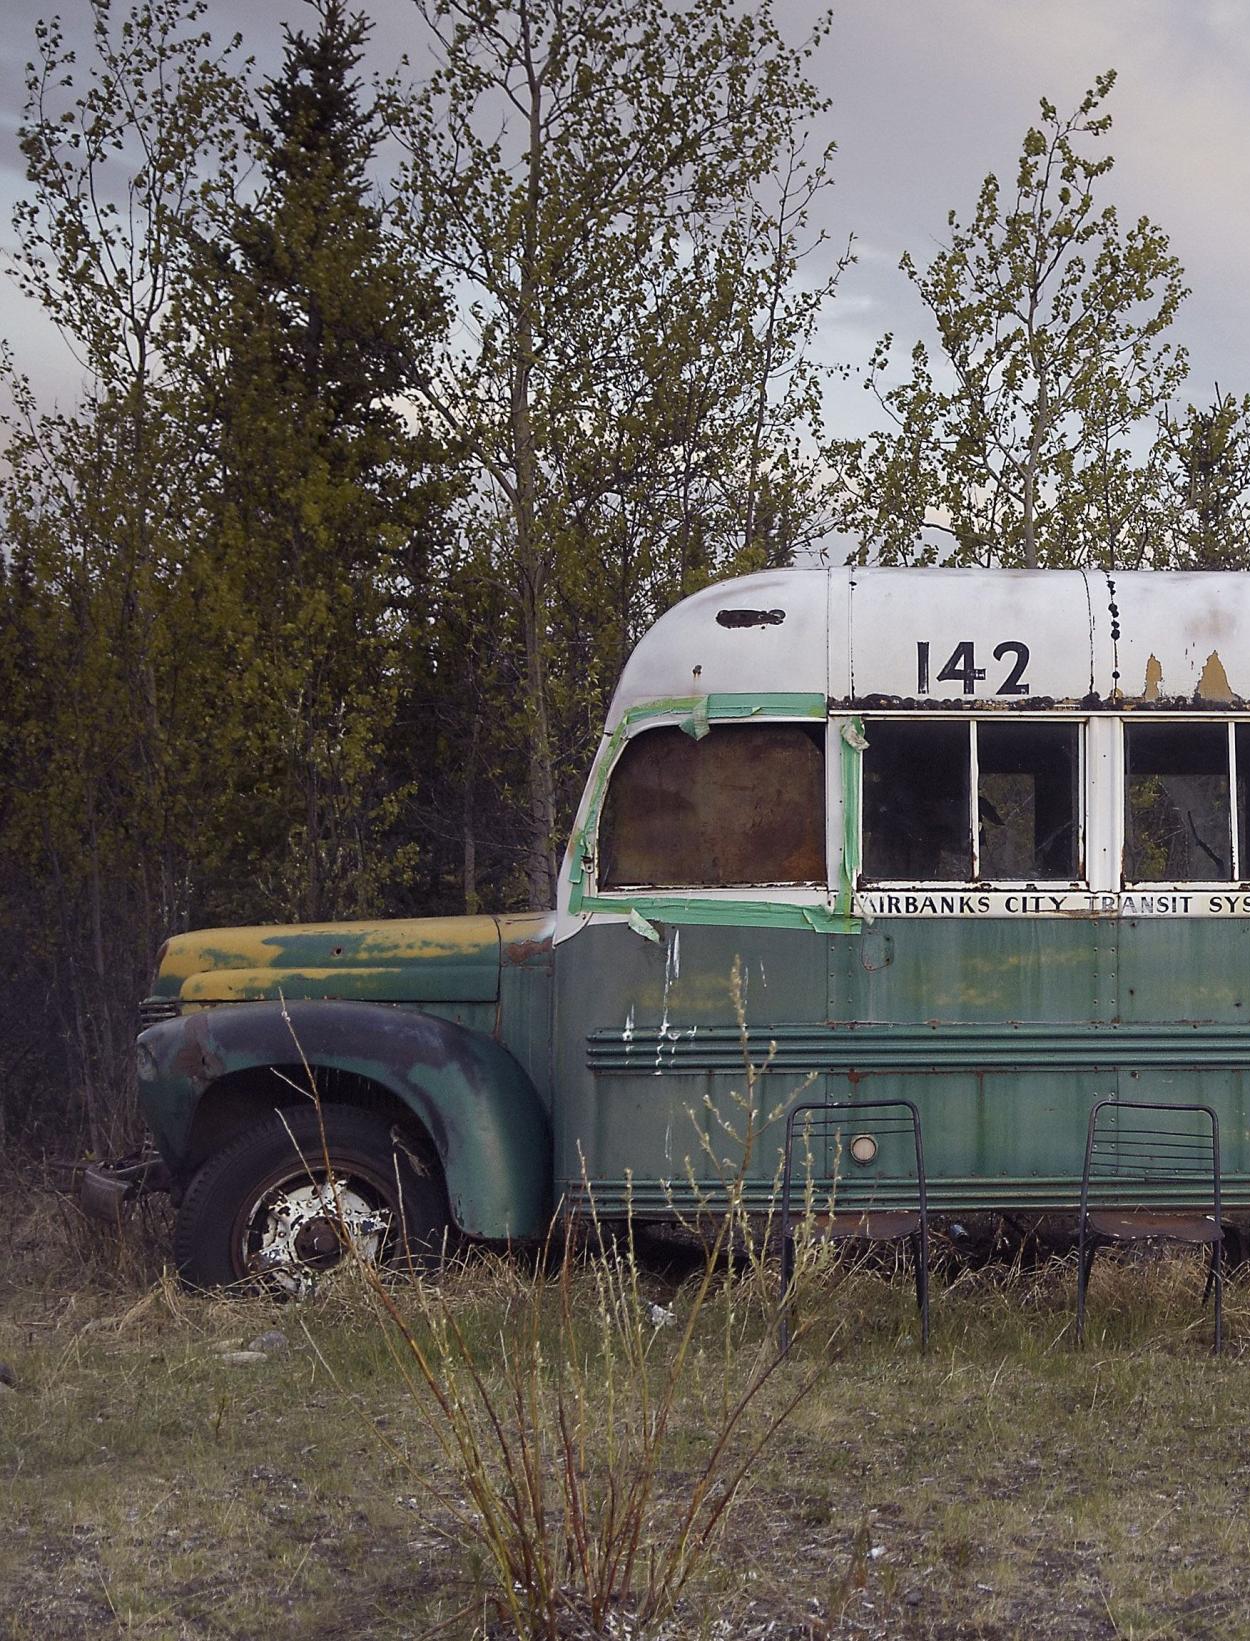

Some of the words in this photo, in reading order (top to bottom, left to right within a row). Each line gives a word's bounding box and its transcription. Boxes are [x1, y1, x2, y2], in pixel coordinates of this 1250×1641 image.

[917, 641, 1030, 695] 142
[1005, 896, 1067, 914] CITY
[1084, 896, 1193, 914] TRANSIT
